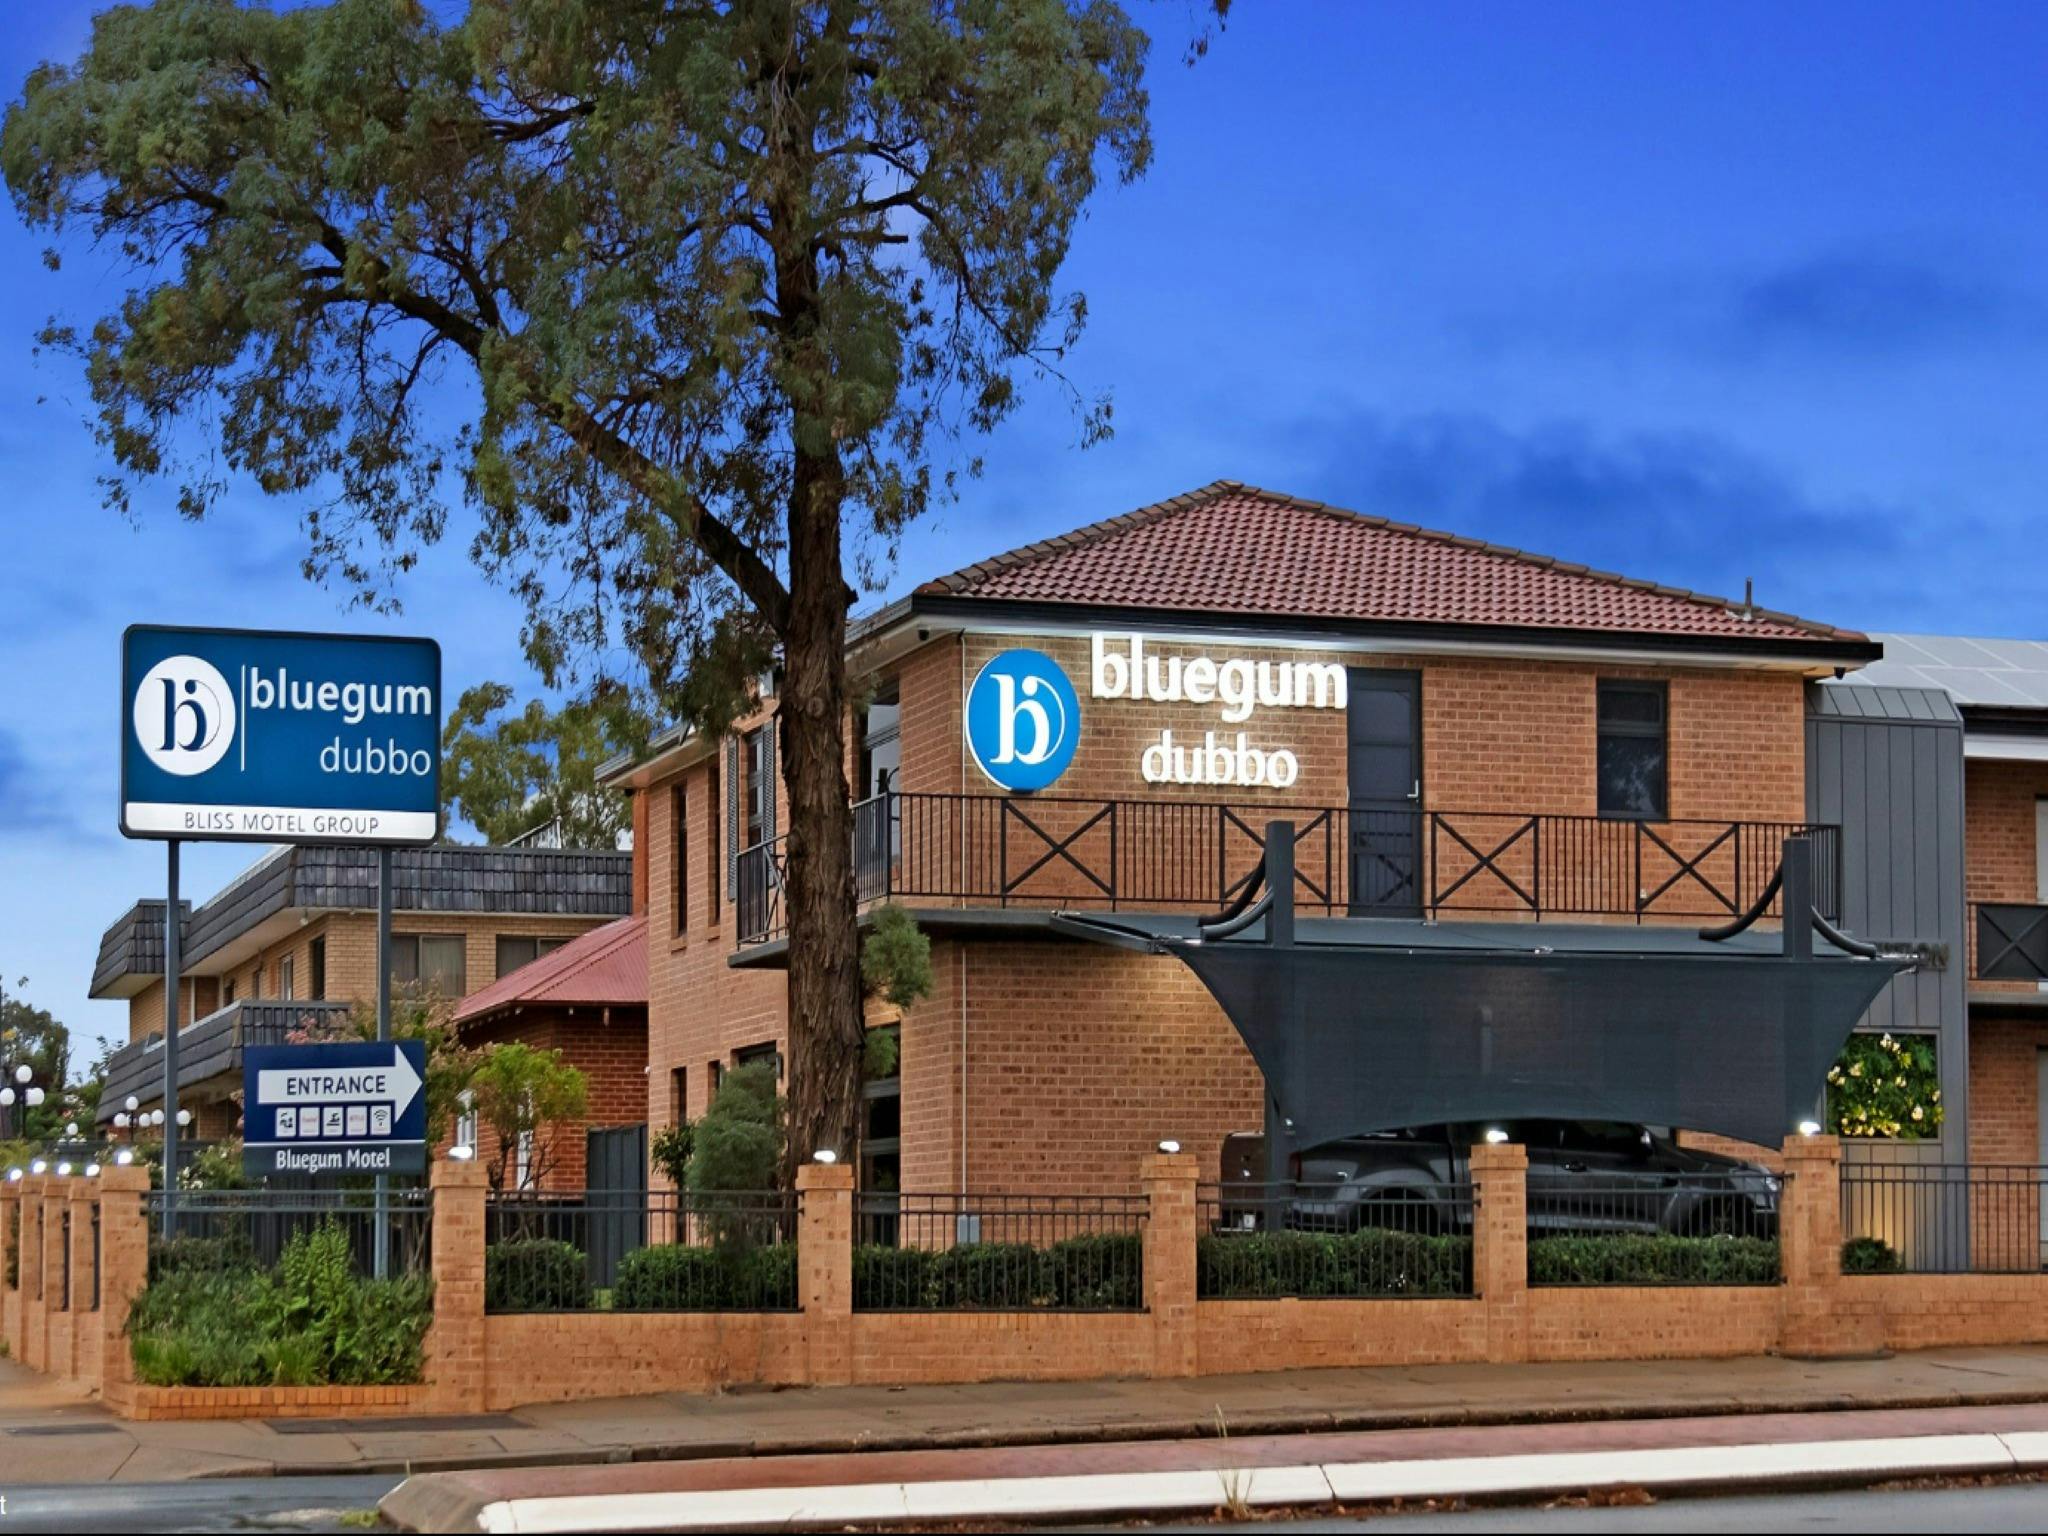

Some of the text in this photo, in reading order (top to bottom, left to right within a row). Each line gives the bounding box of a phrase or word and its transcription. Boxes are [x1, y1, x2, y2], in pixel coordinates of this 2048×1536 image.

[250, 666, 432, 724] bluegum
[1091, 632, 1348, 723] bluegum
[319, 735, 431, 776] dubbo
[1141, 729, 1299, 788] dubbo
[184, 811, 379, 834] BLISS MOTEL GROUP
[286, 1075, 386, 1096] ENTRANCE
[275, 1147, 391, 1173] Bluegum Motel
